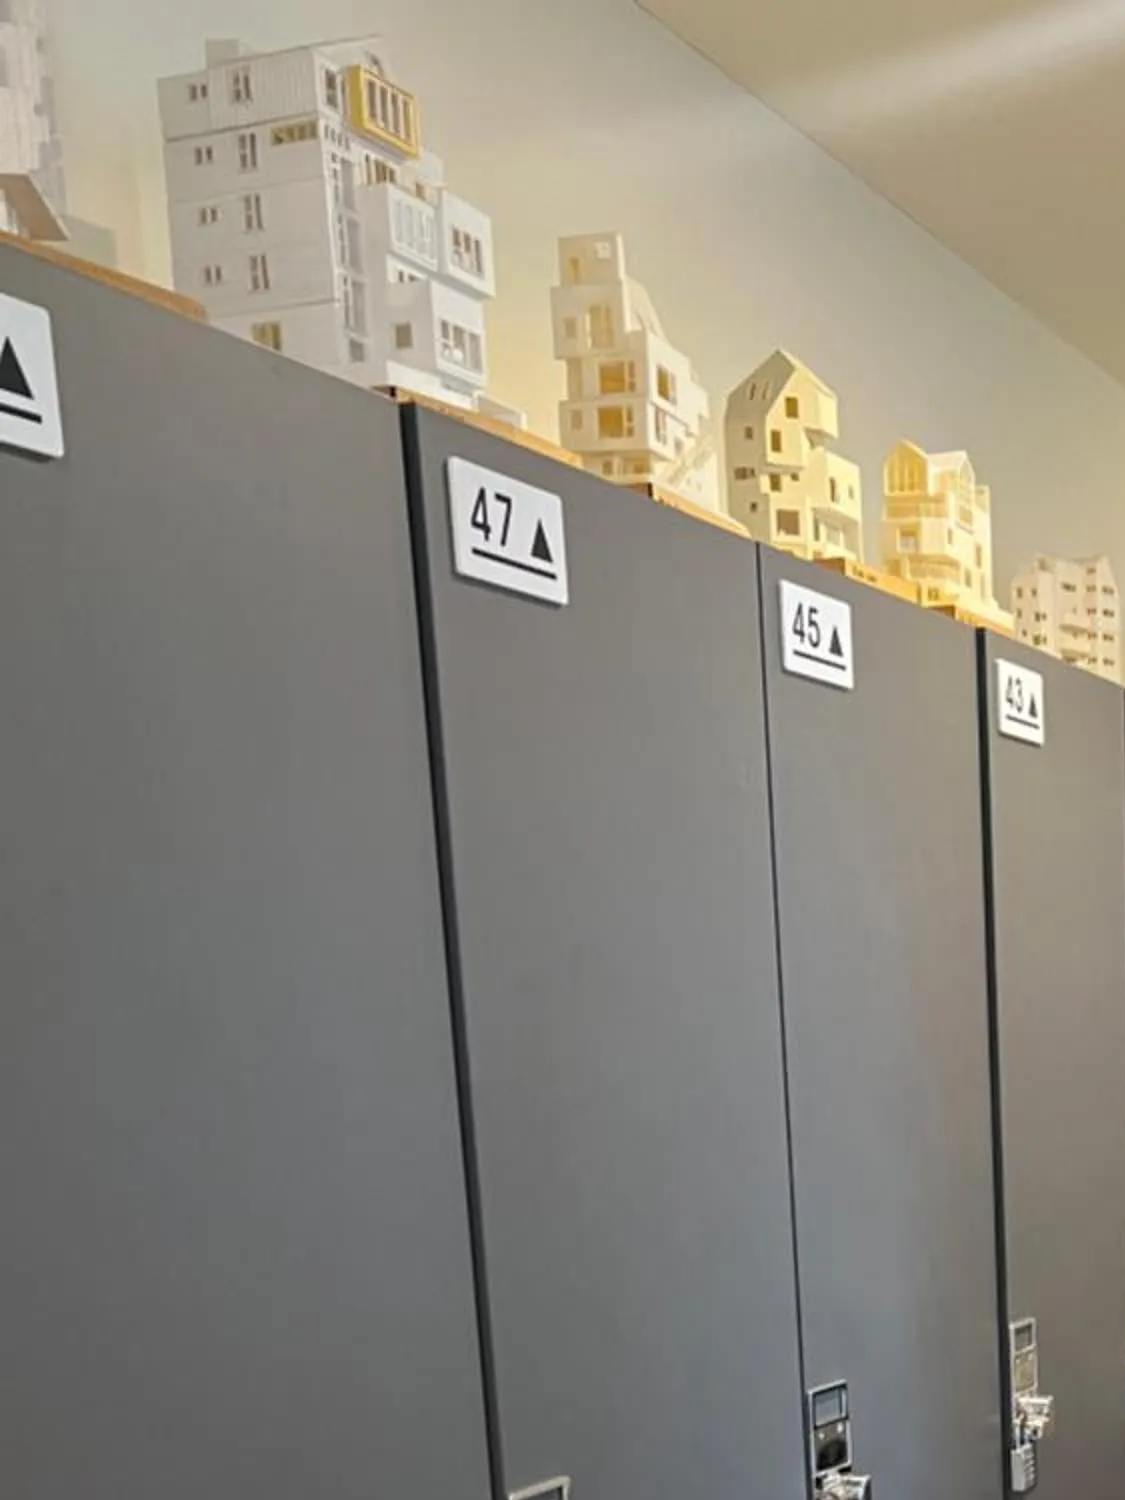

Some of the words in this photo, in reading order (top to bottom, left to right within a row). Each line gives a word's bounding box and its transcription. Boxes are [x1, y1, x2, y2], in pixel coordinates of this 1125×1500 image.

[470, 486, 512, 547] 47
[792, 601, 821, 649] 45
[1005, 675, 1024, 714] 43
